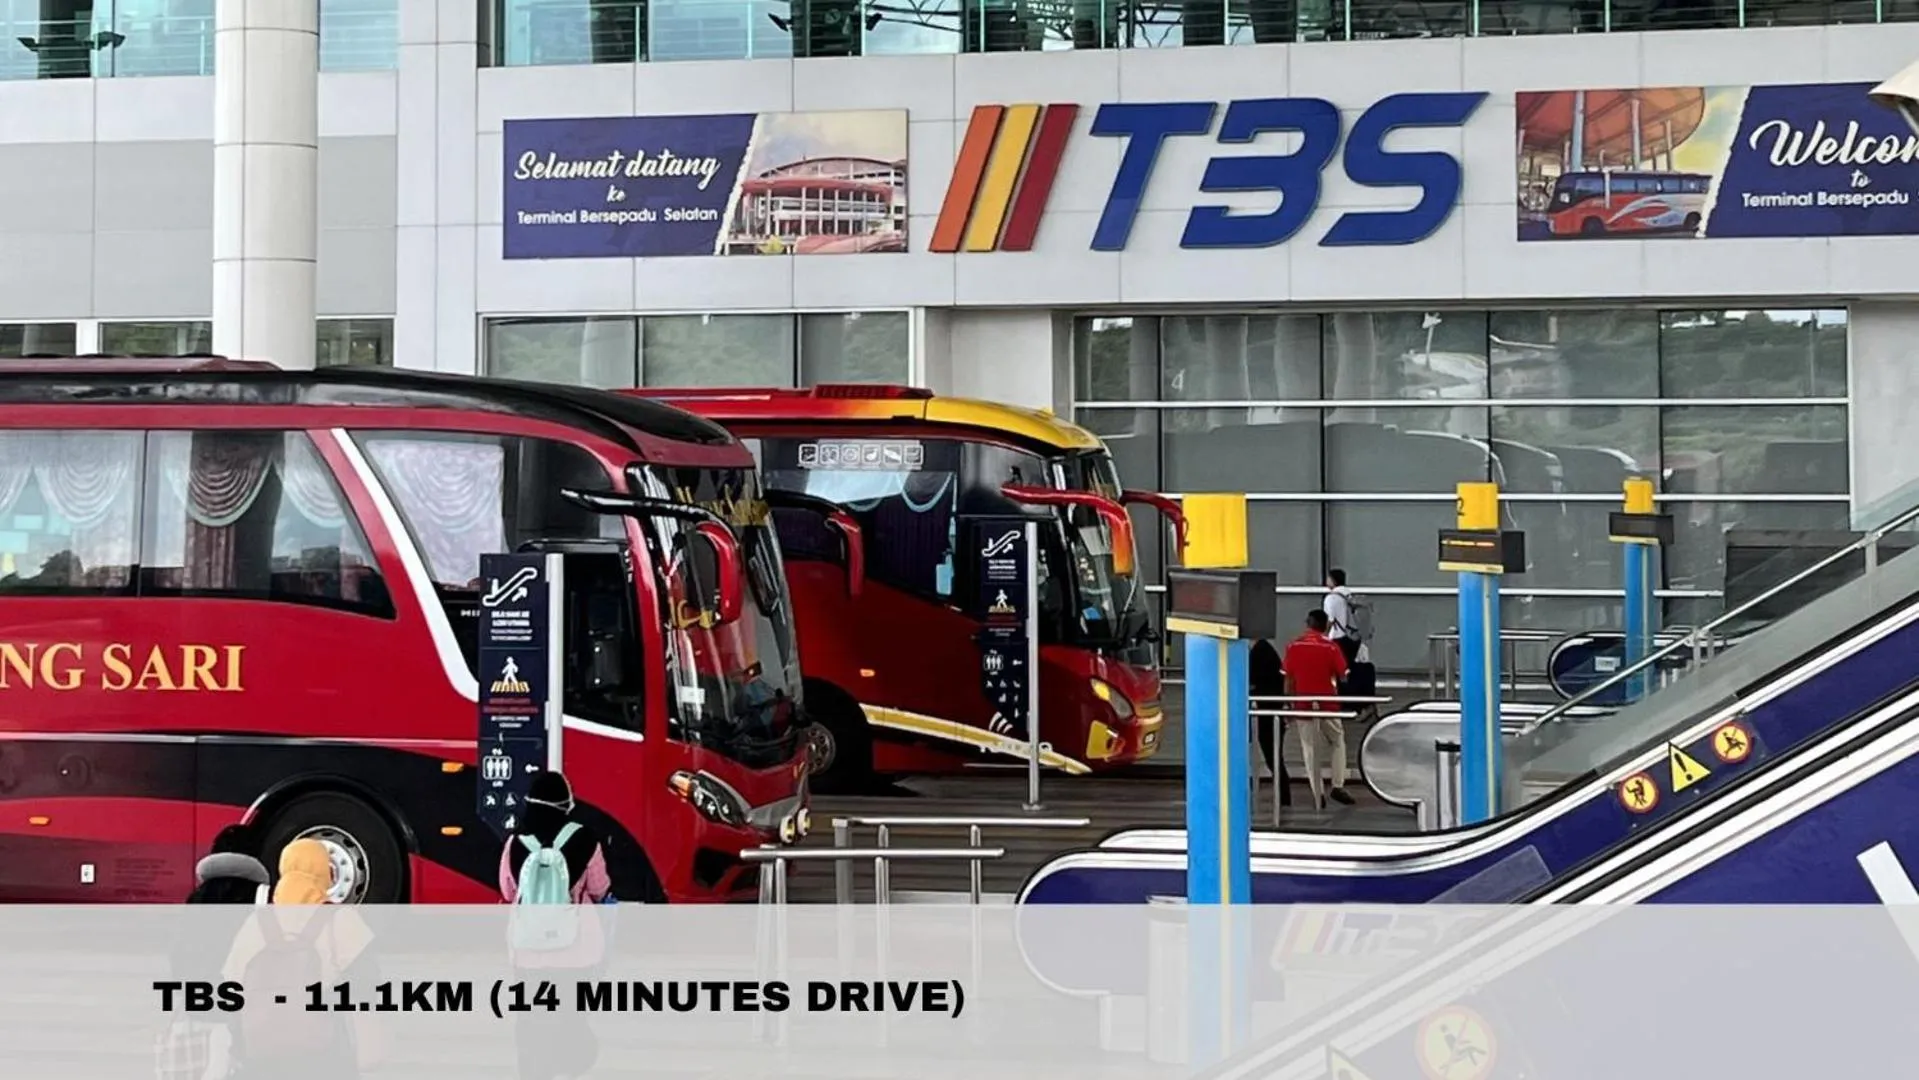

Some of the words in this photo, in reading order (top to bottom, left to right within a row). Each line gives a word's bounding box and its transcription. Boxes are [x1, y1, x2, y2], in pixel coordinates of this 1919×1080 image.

[514, 150, 624, 180] Selamat
[625, 149, 721, 191] datang
[1089, 91, 1490, 250] TBS
[1851, 169, 1871, 188] to
[606, 184, 626, 202] ke
[1743, 191, 1812, 207] Terminal
[1818, 190, 1908, 208] Bersepadu
[517, 210, 577, 225] Terminal
[580, 209, 657, 225] Bersepadu
[663, 207, 718, 222] Selatan
[102, 643, 246, 691] SARI
